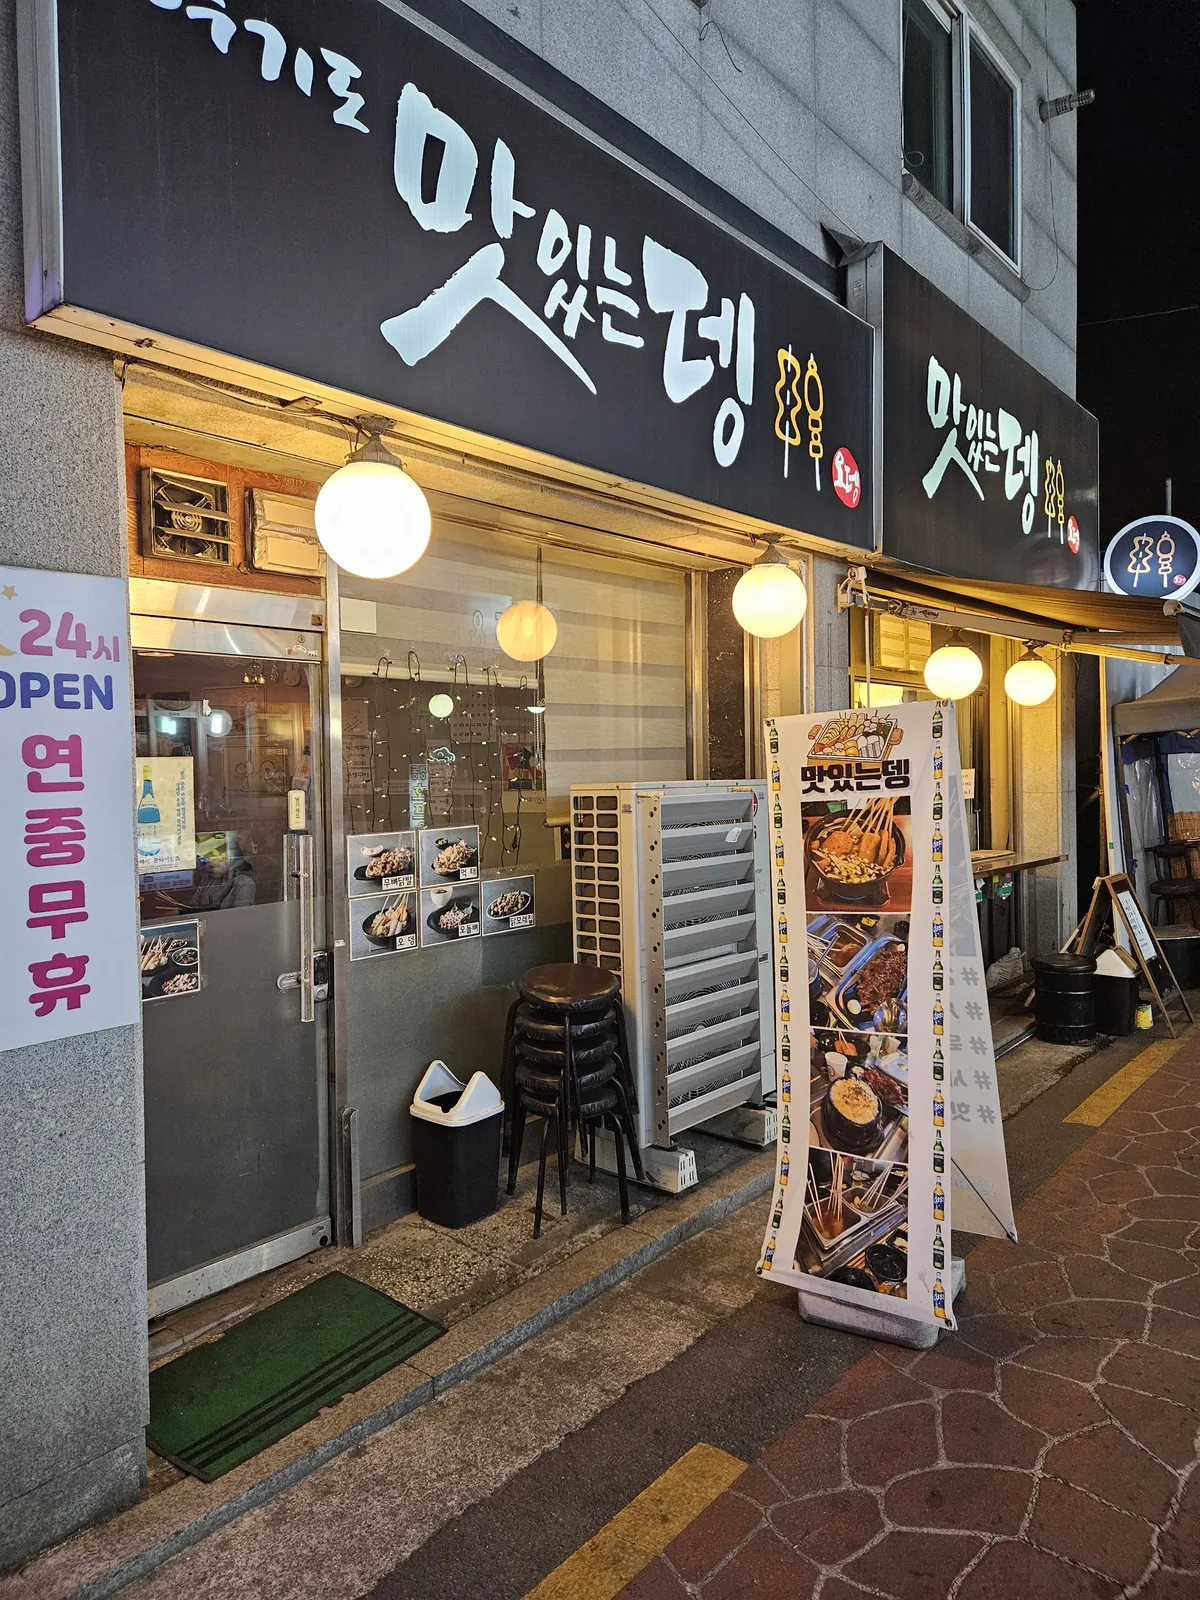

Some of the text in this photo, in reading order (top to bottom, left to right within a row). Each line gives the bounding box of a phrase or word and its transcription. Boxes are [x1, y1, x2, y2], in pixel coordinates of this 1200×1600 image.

[19, 608, 120, 662] 24시
[0, 670, 114, 711] OPEN
[801, 758, 911, 795] 맛있는뎅
[21, 733, 92, 1018] 연중무휴
